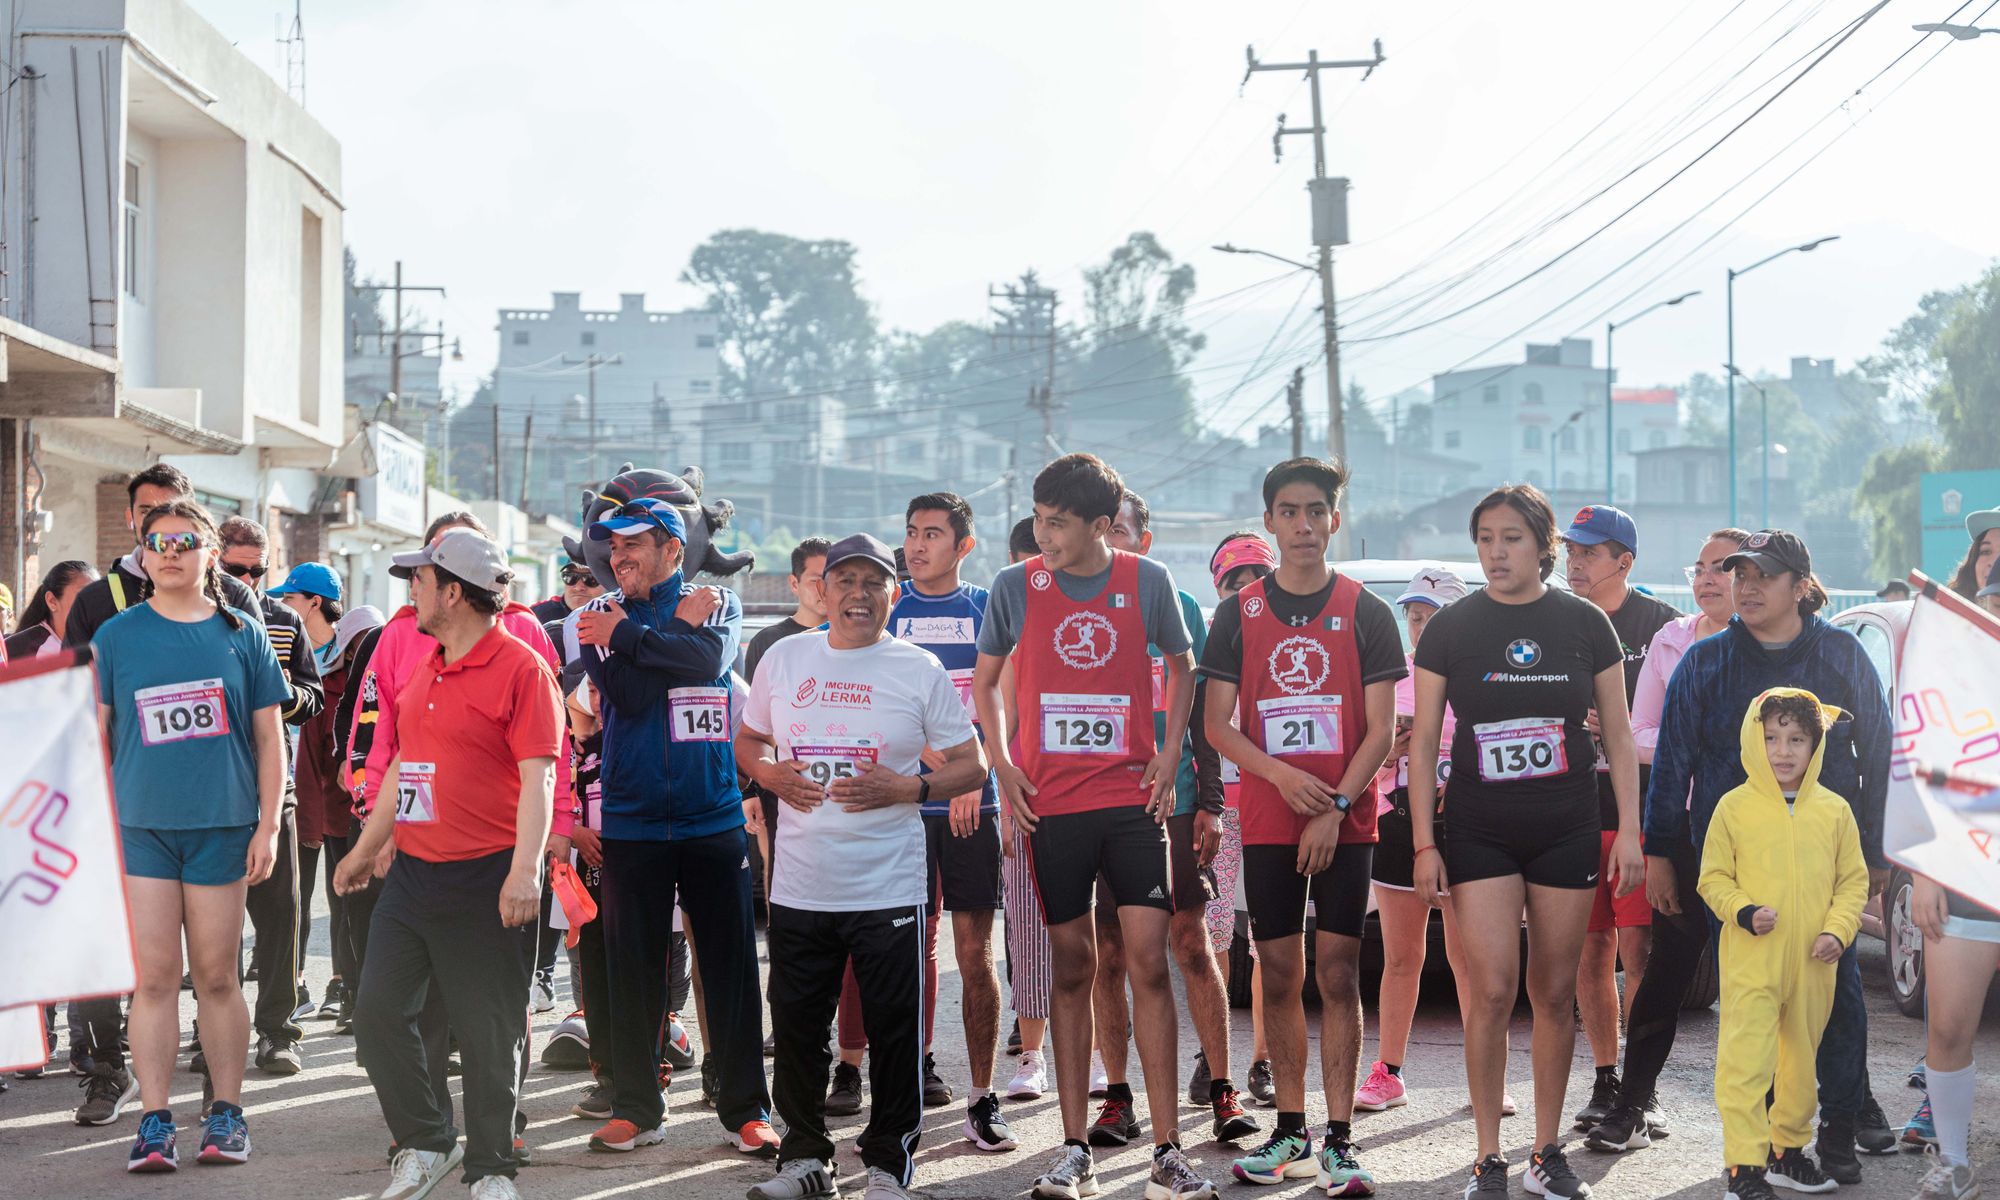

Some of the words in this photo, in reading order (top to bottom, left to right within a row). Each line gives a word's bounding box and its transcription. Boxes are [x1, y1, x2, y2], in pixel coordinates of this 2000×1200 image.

[927, 624, 953, 632] DAGA
[825, 681, 873, 693] IMCUFIDE
[1509, 674, 1570, 682] Motorsport
[821, 691, 872, 704] LERMA
[153, 704, 213, 734] 108
[682, 710, 723, 733] 145
[1055, 720, 1113, 746] 129
[1282, 720, 1315, 746] 21
[1490, 742, 1552, 773] 130
[810, 762, 852, 786] 95
